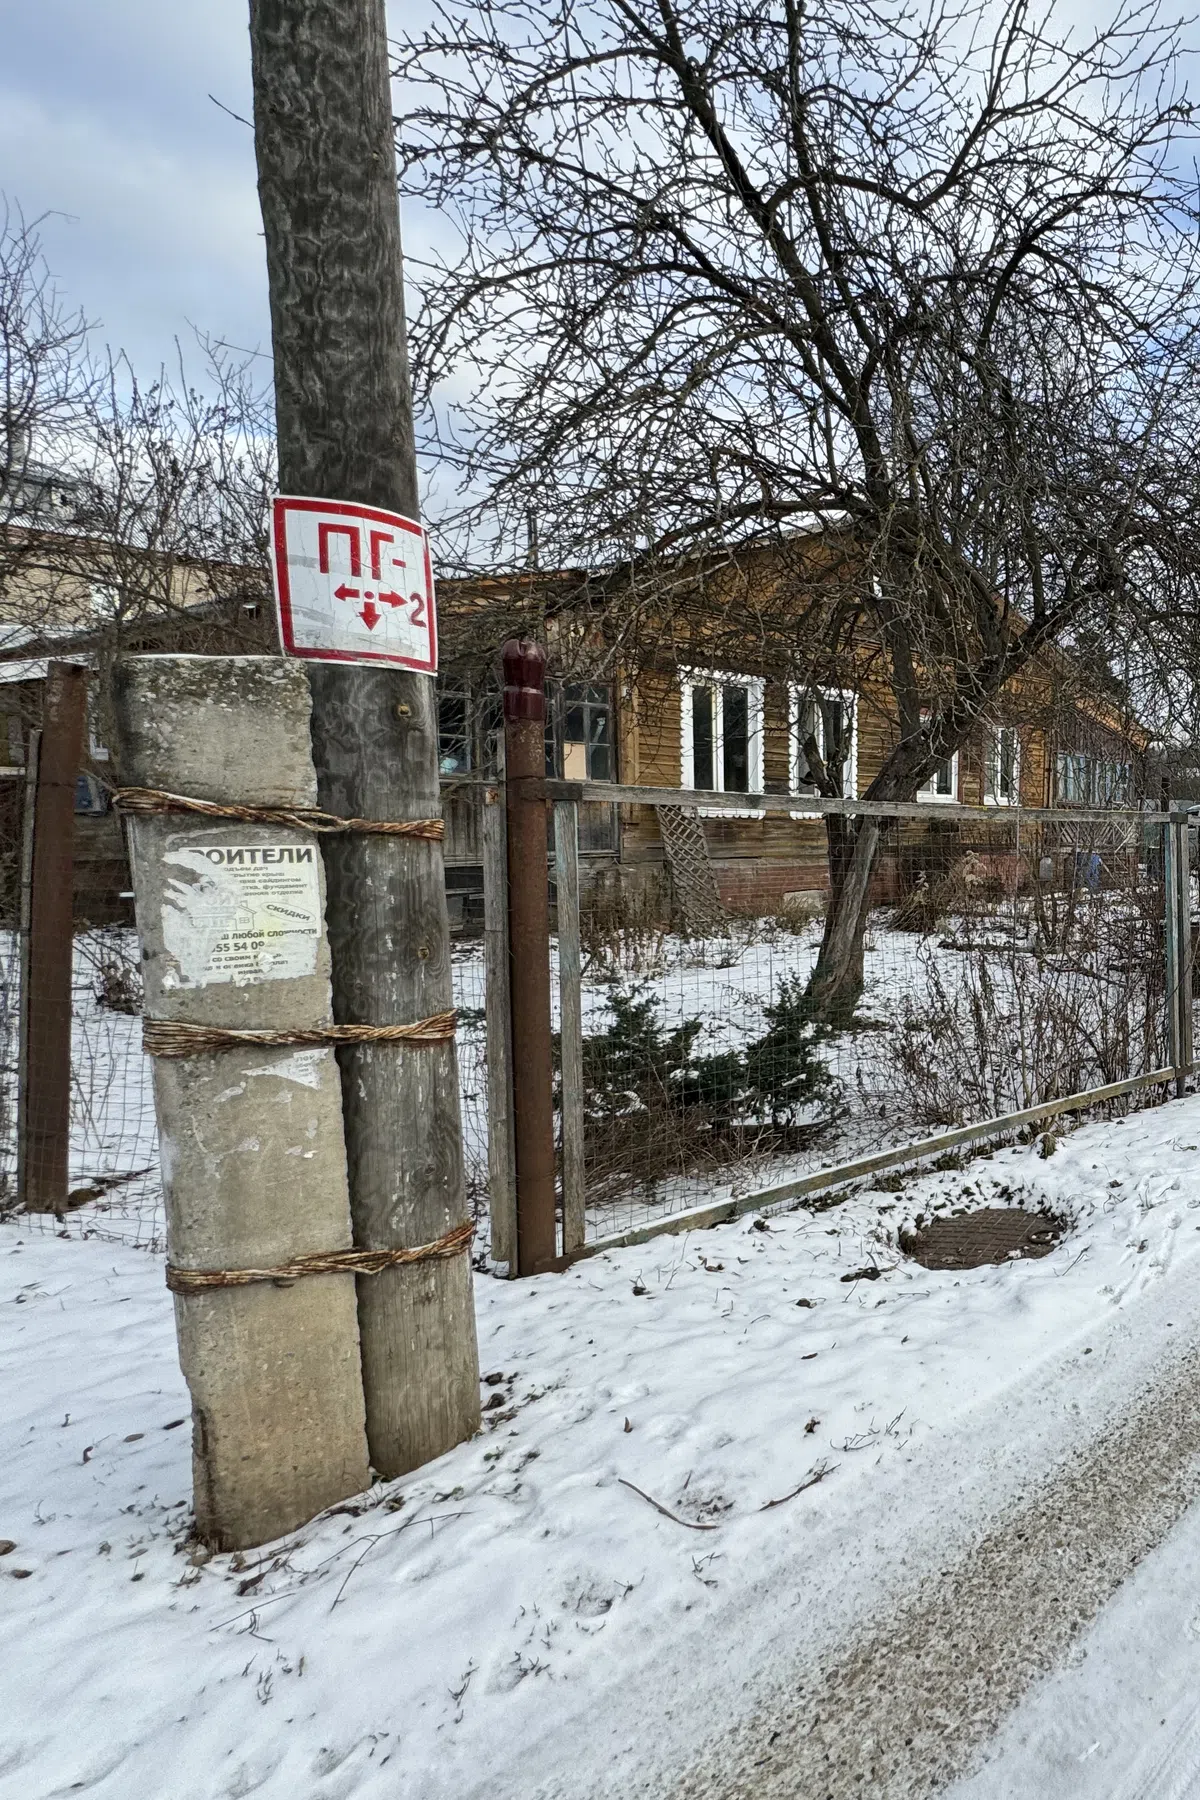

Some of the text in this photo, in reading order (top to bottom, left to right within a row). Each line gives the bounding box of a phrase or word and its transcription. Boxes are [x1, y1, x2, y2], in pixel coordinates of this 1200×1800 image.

[318, 523, 406, 580] ПГ-
[409, 592, 427, 628] 2
[266, 904, 311, 921] скидки
[231, 929, 265, 939] любой
[211, 942, 230, 953] 55
[233, 942, 248, 951] 54
